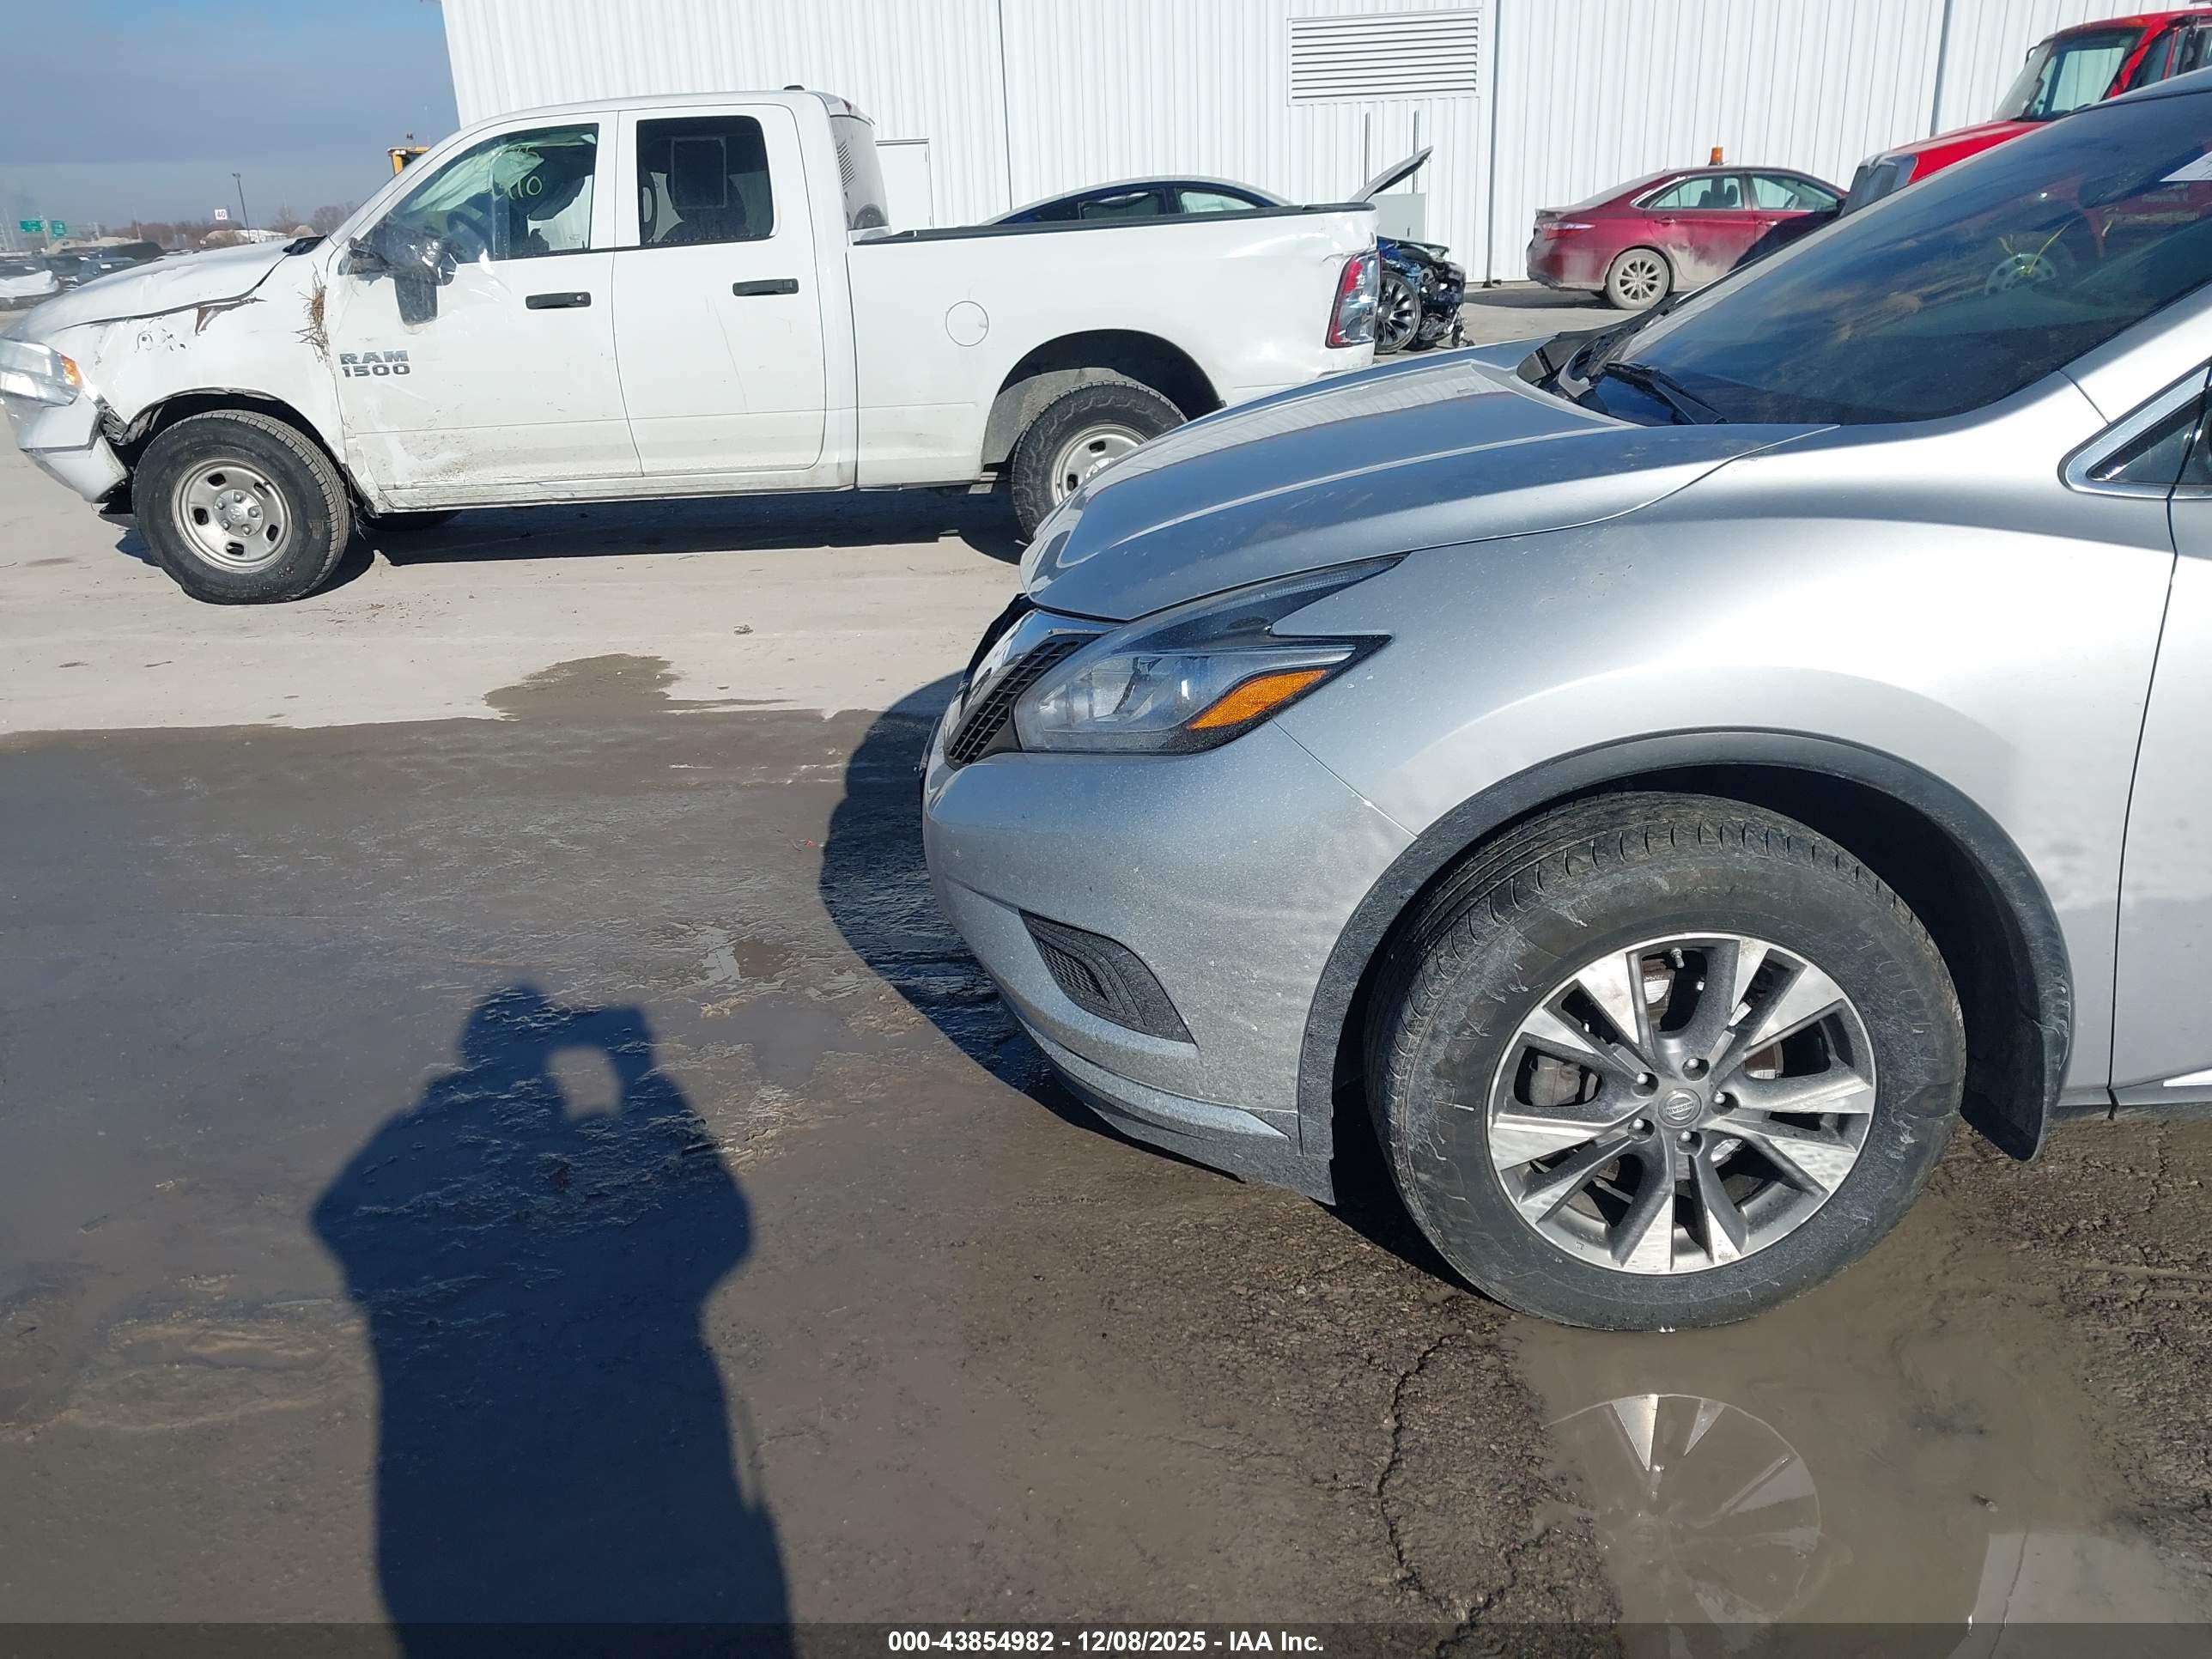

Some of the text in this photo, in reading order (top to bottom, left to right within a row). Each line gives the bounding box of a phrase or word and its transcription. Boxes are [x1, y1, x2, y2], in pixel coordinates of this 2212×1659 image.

[339, 349, 410, 365] RAM
[342, 362, 410, 378] 1500
[1666, 1102, 1694, 1115] NISSAN
